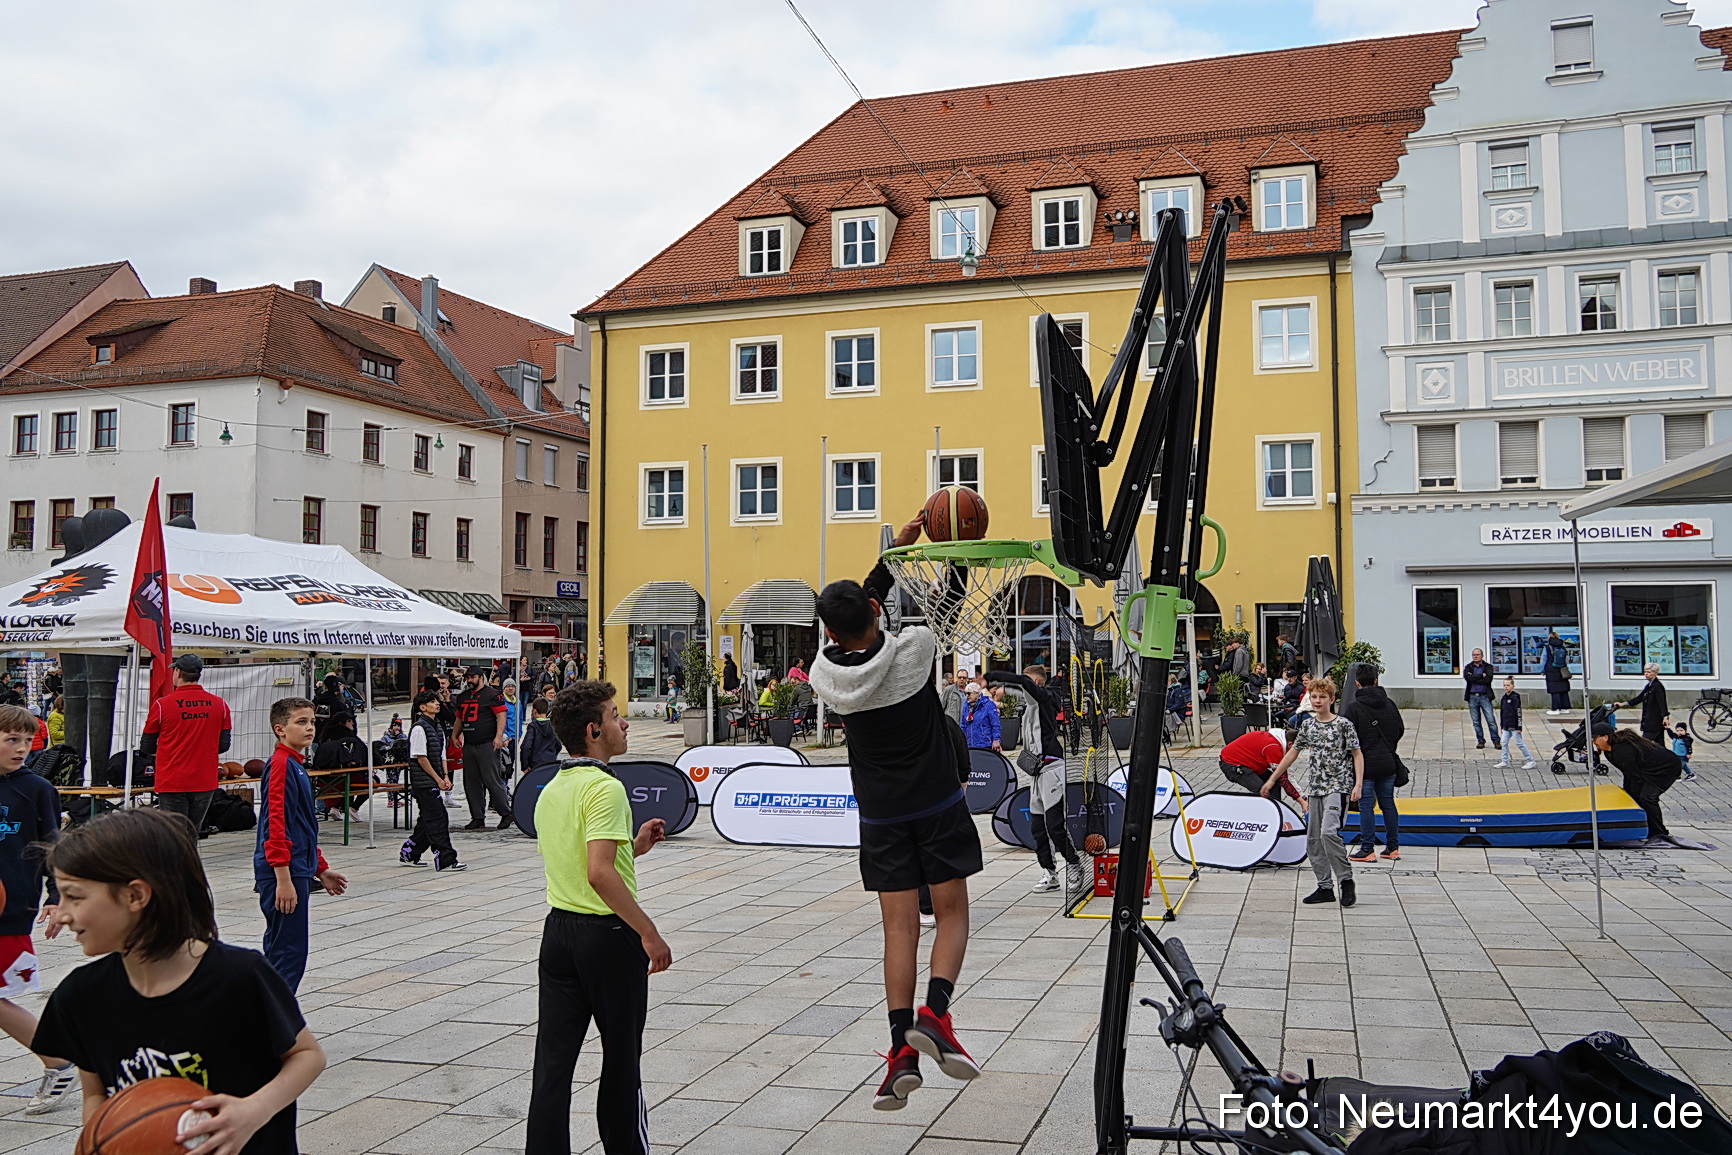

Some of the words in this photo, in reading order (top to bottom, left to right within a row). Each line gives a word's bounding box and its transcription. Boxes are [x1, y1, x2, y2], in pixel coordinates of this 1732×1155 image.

[1503, 362, 1598, 388] BRILLEN
[1604, 357, 1697, 382] WEBER
[1491, 526, 1552, 541] RÄTZER
[1557, 525, 1652, 540] IMMOBILIEN
[560, 582, 579, 592] CECIL
[10, 613, 77, 629] LORENZ
[5, 631, 51, 642] SERVICE
[170, 621, 241, 641] esuchen
[245, 624, 268, 643] Sie
[273, 630, 300, 644] uns
[303, 628, 321, 645] im
[324, 628, 374, 646] Internet
[376, 631, 405, 646] unter
[407, 632, 509, 649] www.reifen-lorenz.de
[460, 703, 479, 722] 73
[761, 793, 846, 808] J.PRÖPSTER
[1205, 819, 1235, 829] REIFEN
[1235, 821, 1269, 832] LORENZ
[1214, 830, 1231, 838] AUTO
[1231, 831, 1256, 840] SERVICE
